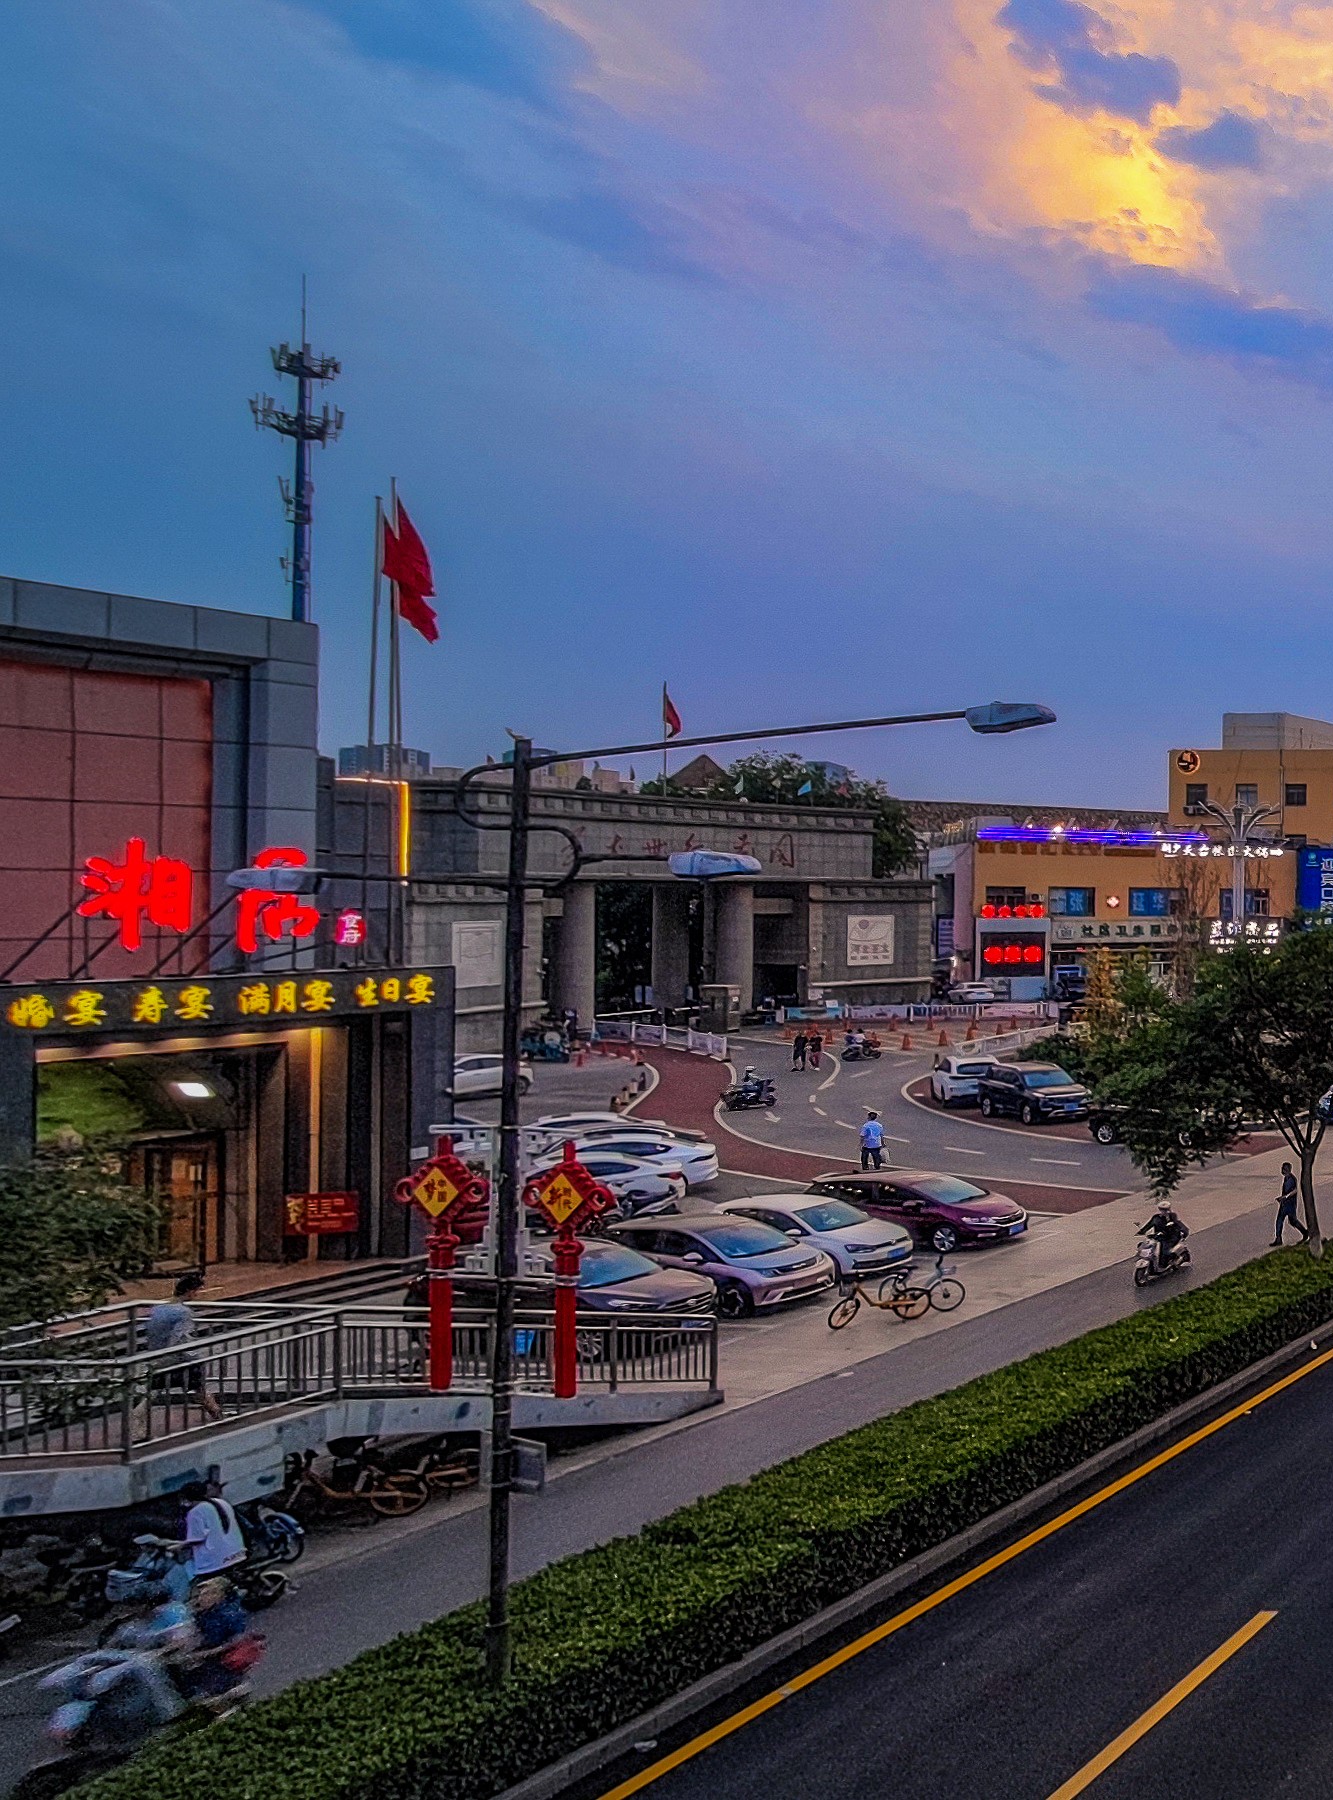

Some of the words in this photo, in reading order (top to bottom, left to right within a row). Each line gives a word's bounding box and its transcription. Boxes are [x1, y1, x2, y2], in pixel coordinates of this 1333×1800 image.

[8, 989, 107, 1028] 婚宴
[133, 985, 215, 1023] 寿宴
[238, 979, 336, 1014] 满月宴
[355, 974, 436, 1007] 生日宴
